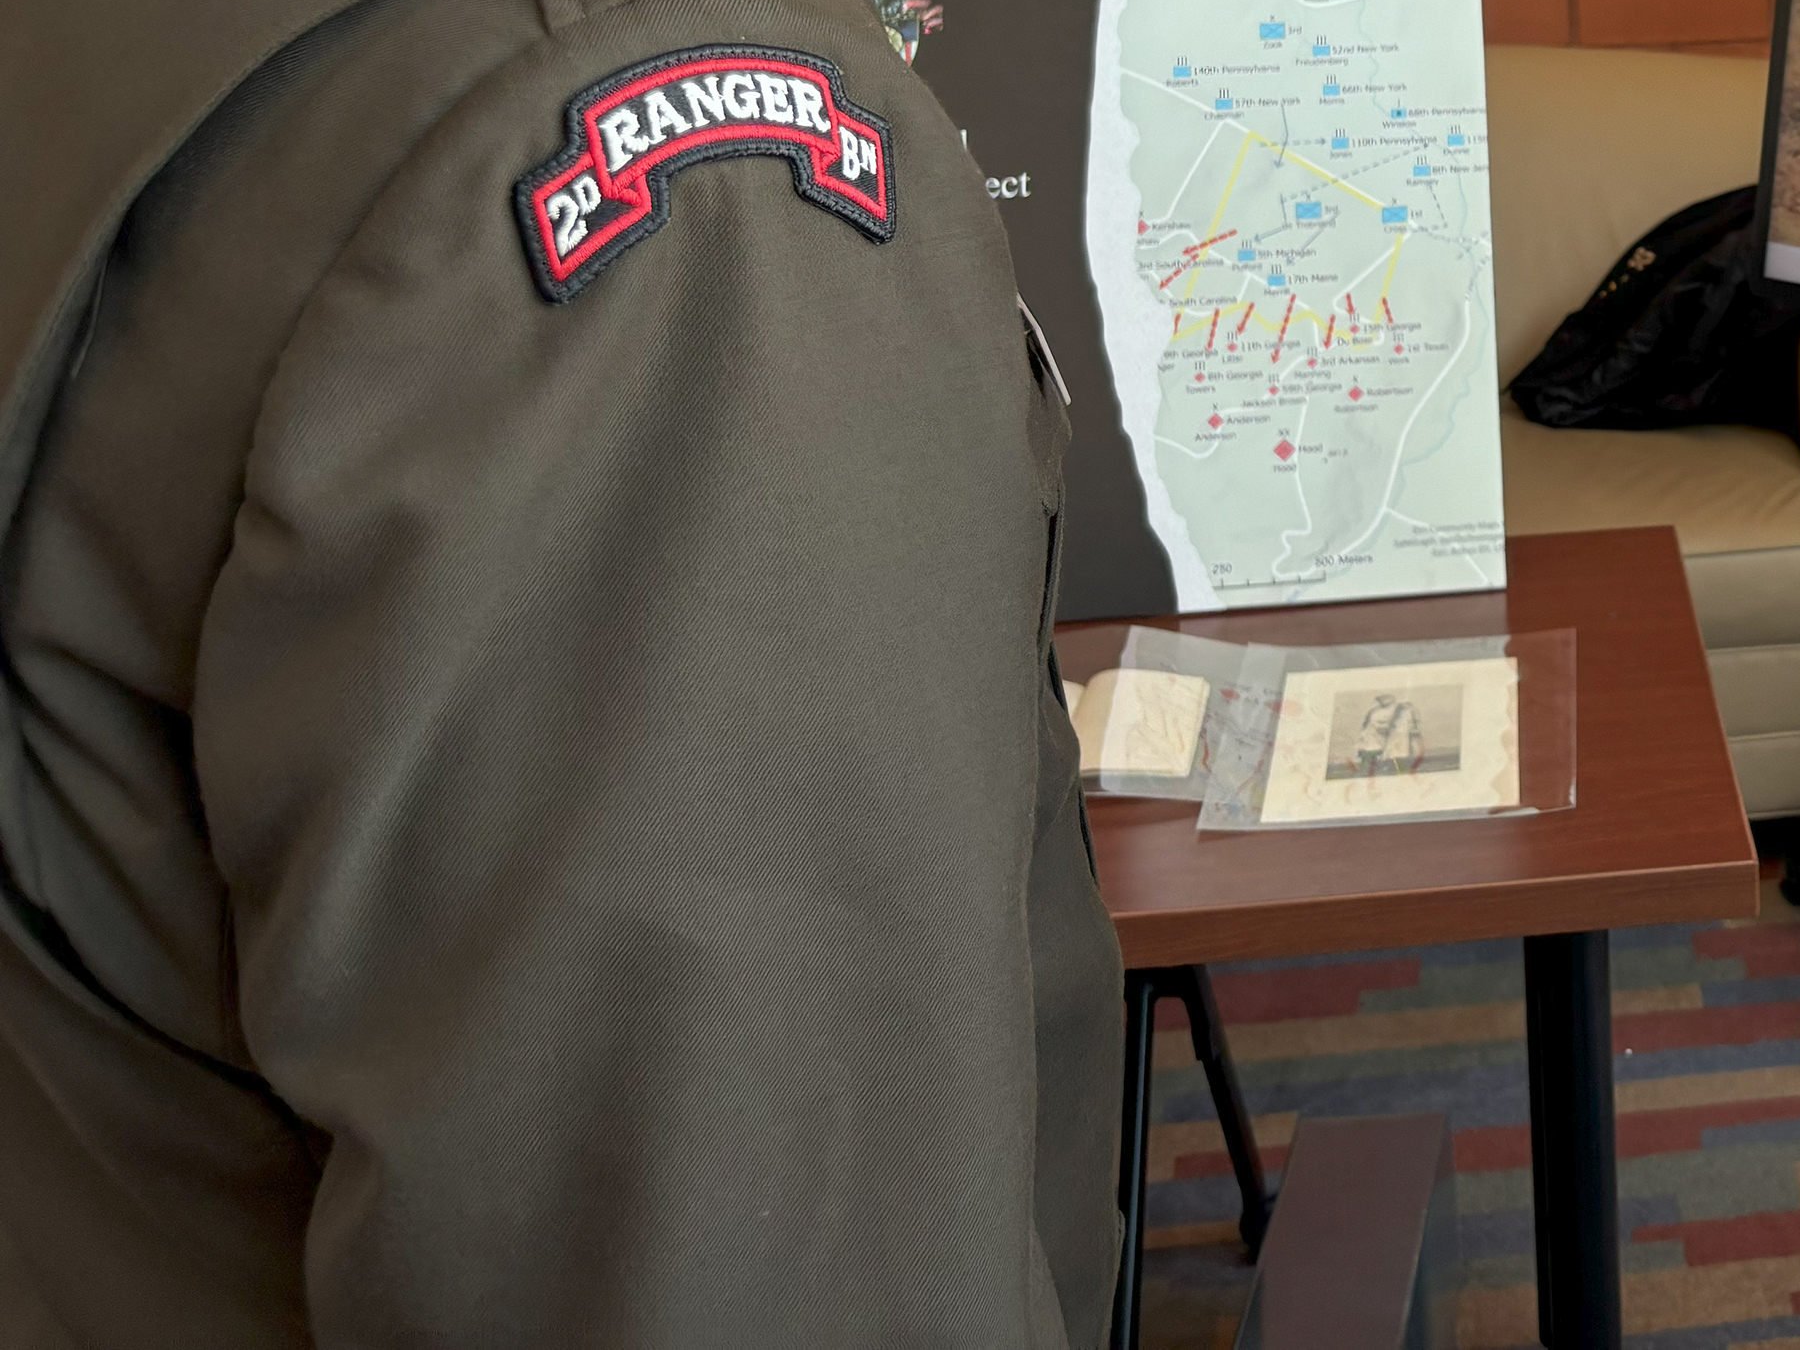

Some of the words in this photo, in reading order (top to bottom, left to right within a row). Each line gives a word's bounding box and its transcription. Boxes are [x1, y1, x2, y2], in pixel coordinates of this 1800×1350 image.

[1357, 45, 1377, 54] New
[1380, 43, 1399, 52] York
[1365, 85, 1385, 93] New
[1387, 84, 1407, 92] York
[1258, 98, 1279, 107] New
[547, 175, 601, 257] 2D
[599, 71, 832, 171] RANGER
[838, 124, 877, 181] BN
